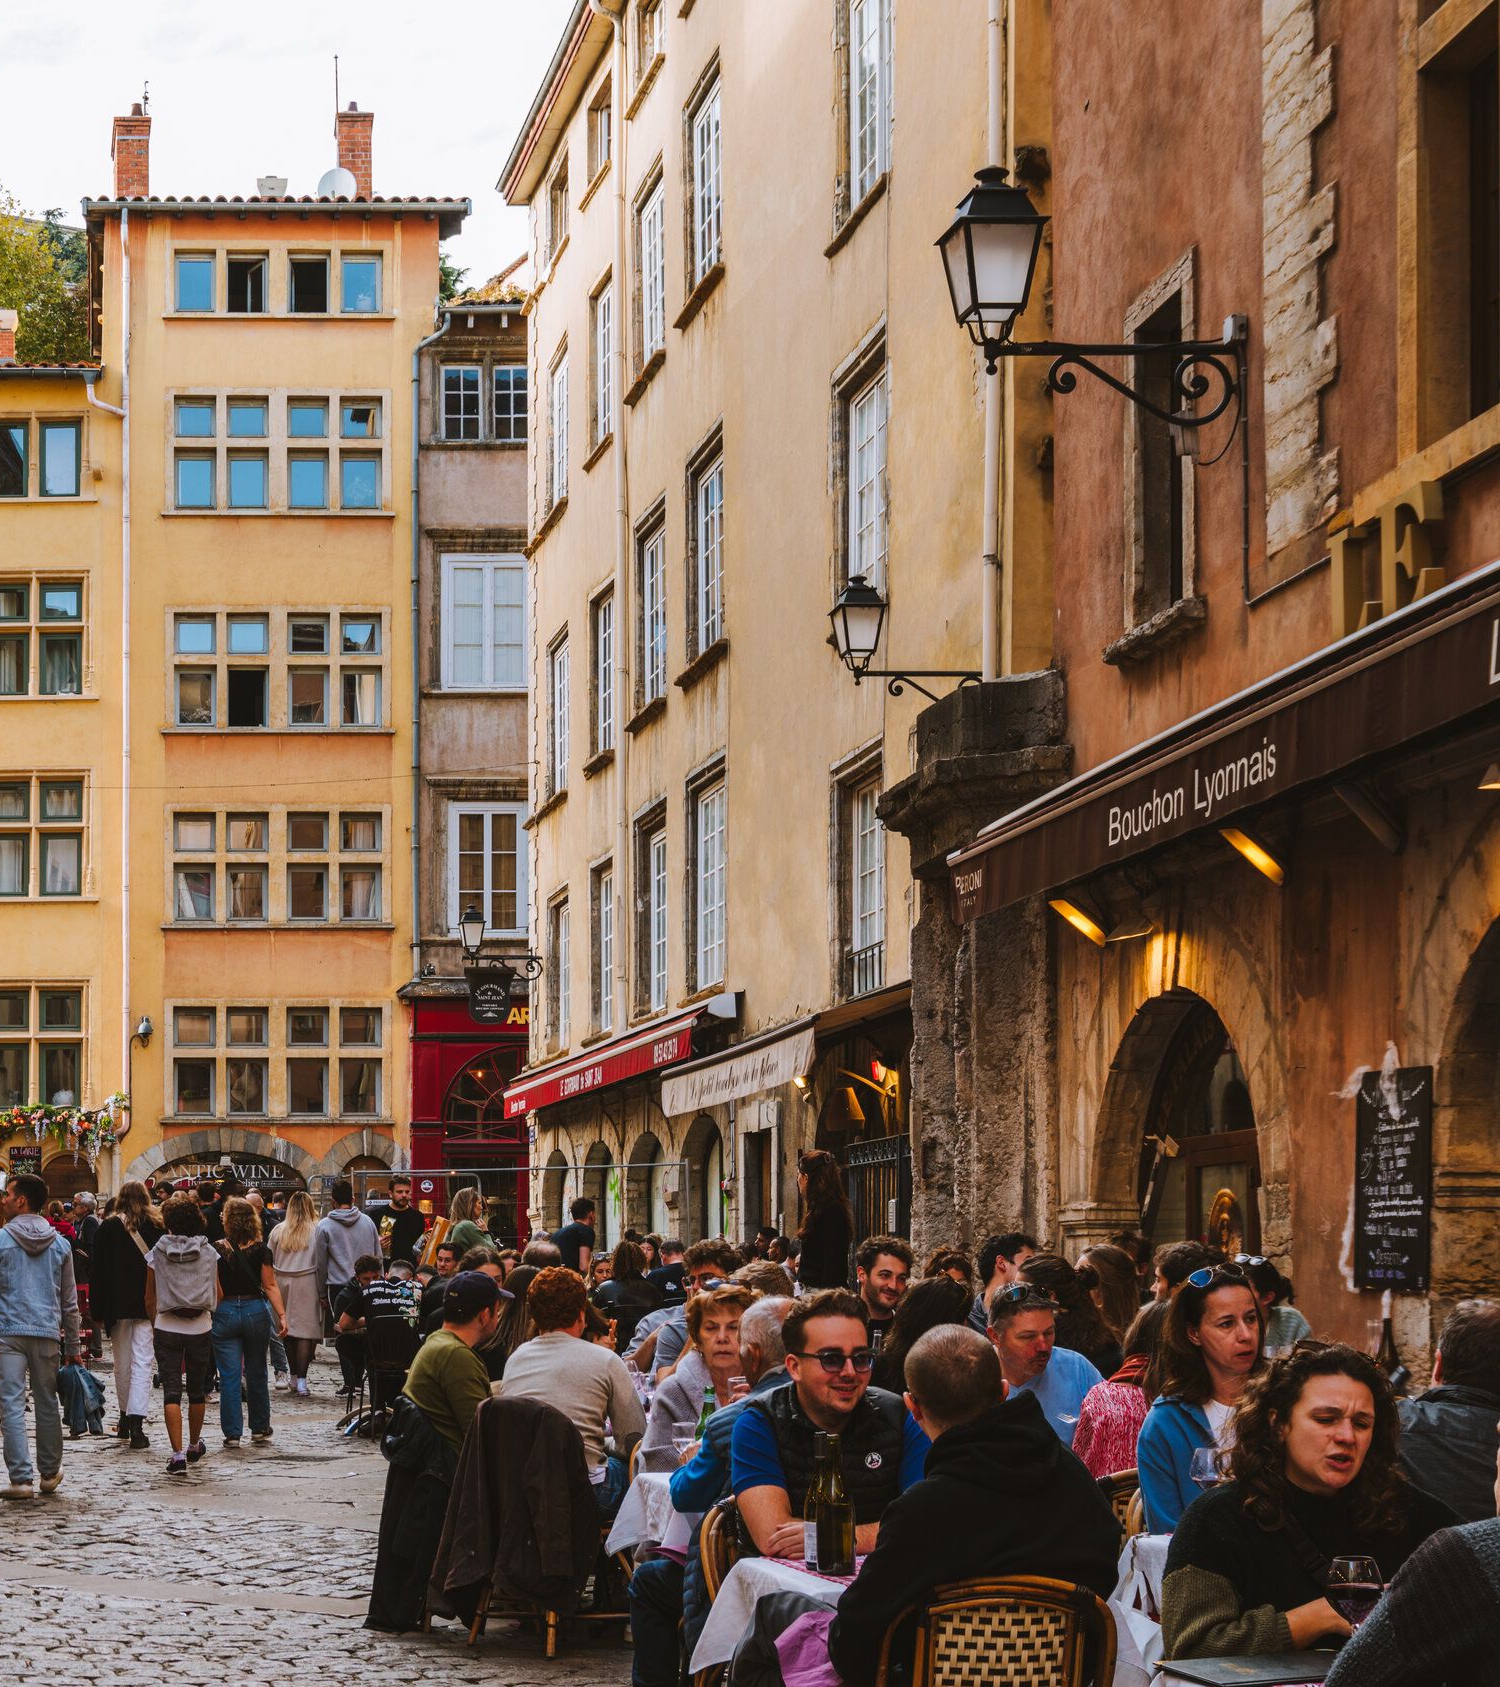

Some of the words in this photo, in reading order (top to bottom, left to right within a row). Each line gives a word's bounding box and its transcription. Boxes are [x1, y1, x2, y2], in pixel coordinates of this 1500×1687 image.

[1108, 787, 1184, 847] Bouchon
[1193, 737, 1277, 818] Lyonnais
[955, 869, 982, 895] PERONI
[698, 1074, 714, 1106] petit
[716, 1065, 740, 1097] bouchon
[743, 1066, 749, 1083] de
[751, 1057, 759, 1082] la
[165, 1163, 225, 1178] ANTIC
